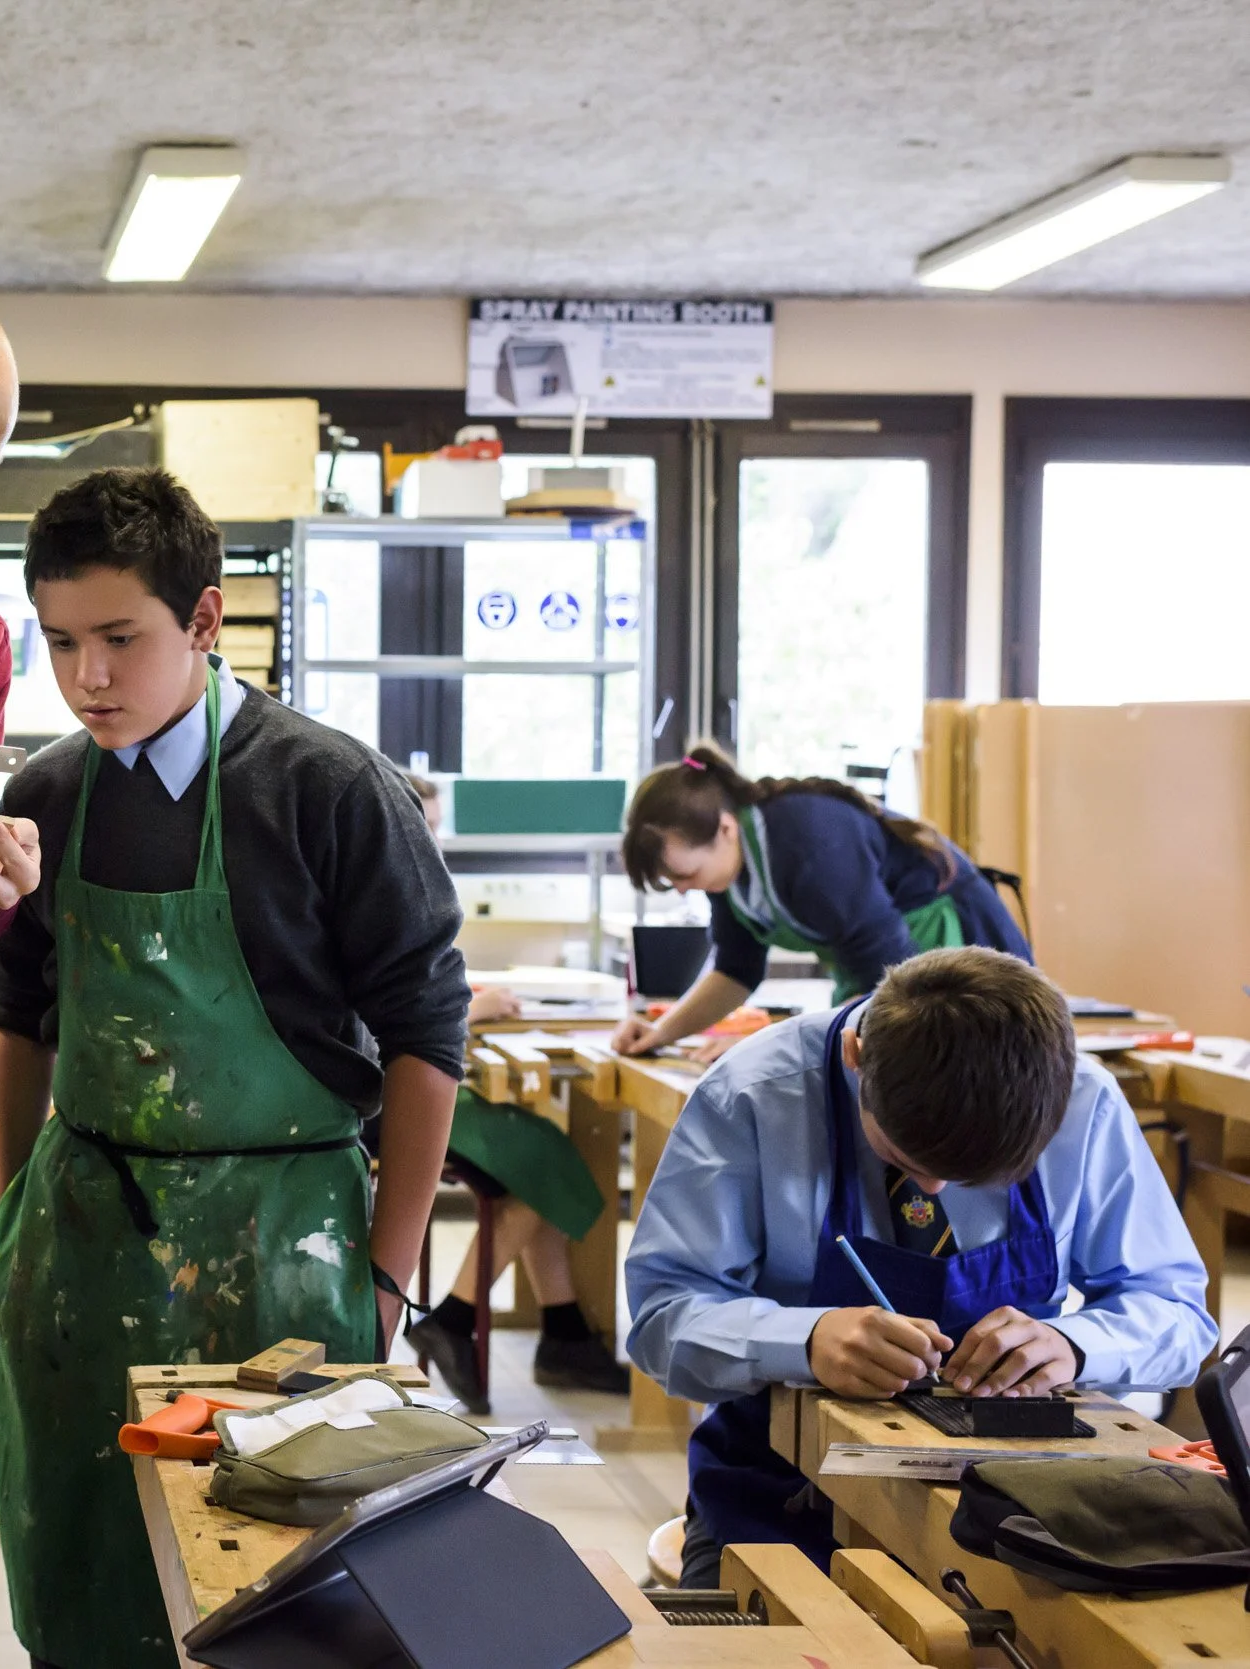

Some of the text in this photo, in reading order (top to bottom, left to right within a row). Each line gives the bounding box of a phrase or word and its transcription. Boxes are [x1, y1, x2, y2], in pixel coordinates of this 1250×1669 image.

[480, 300, 765, 323] SPRAY PAINTING BOOTH
